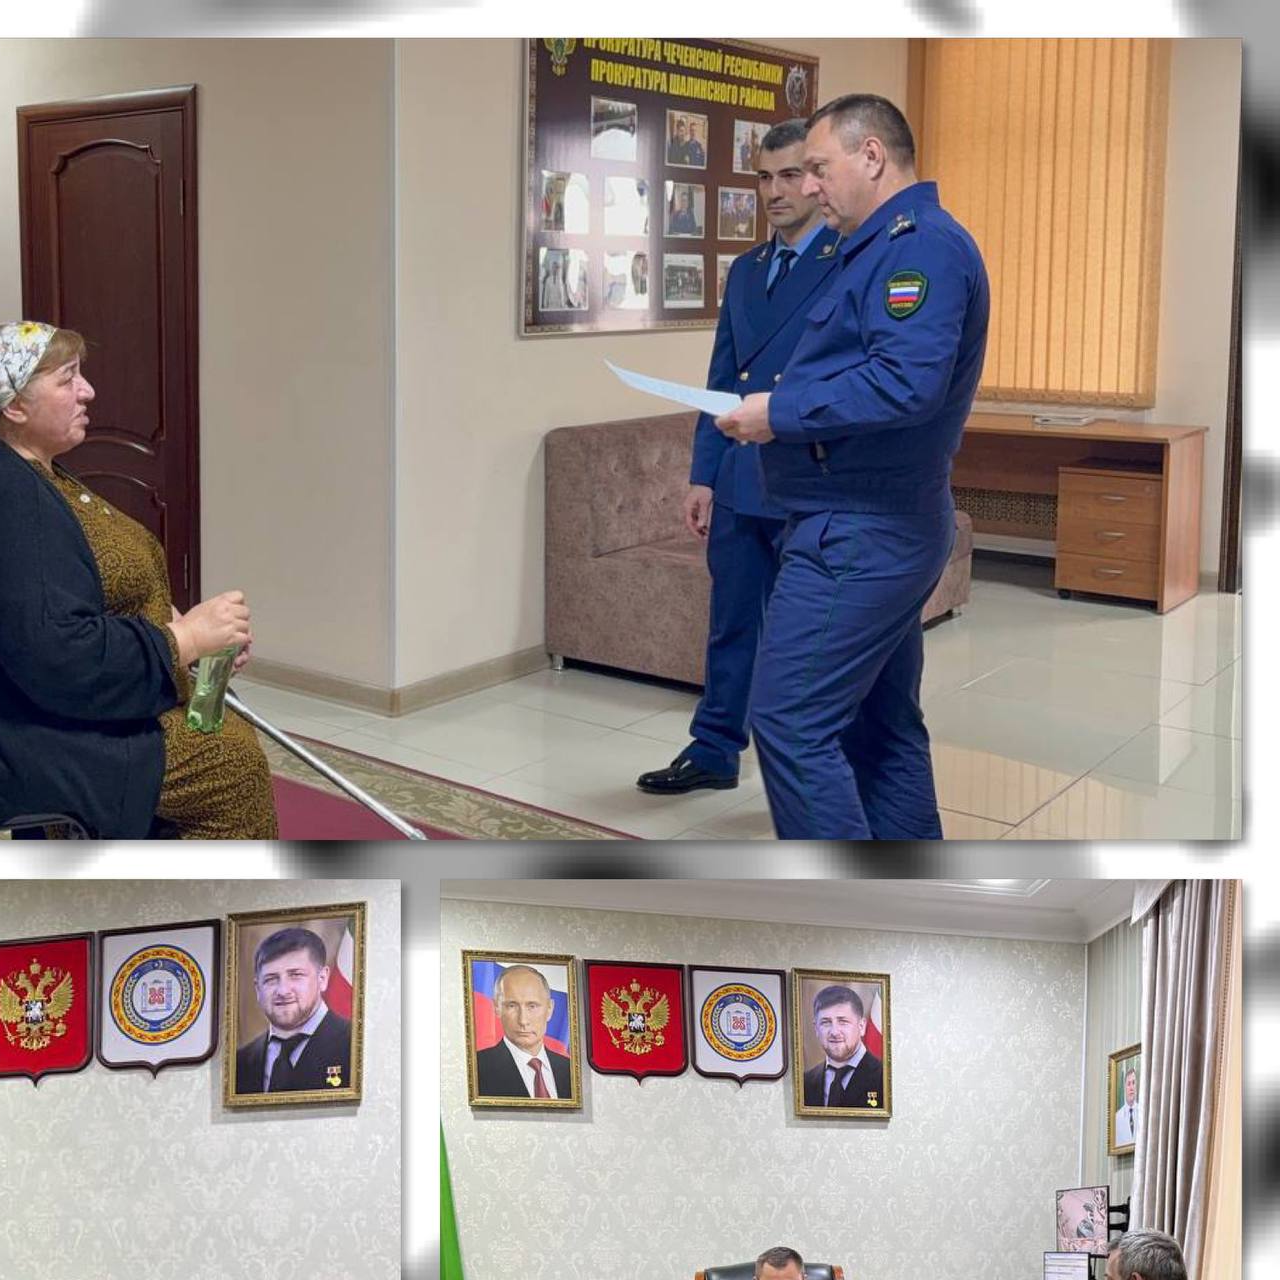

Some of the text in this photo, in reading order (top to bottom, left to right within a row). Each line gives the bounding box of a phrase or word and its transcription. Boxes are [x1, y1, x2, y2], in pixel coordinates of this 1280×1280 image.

[591, 58, 774, 112] ПРОКУРАТУРА ШАЛИНСКОГО РАЙОНА
[664, 41, 723, 73] ЧЕЧЕНСКОЙ
[724, 54, 783, 85] РЕСПУБЛИКИ
